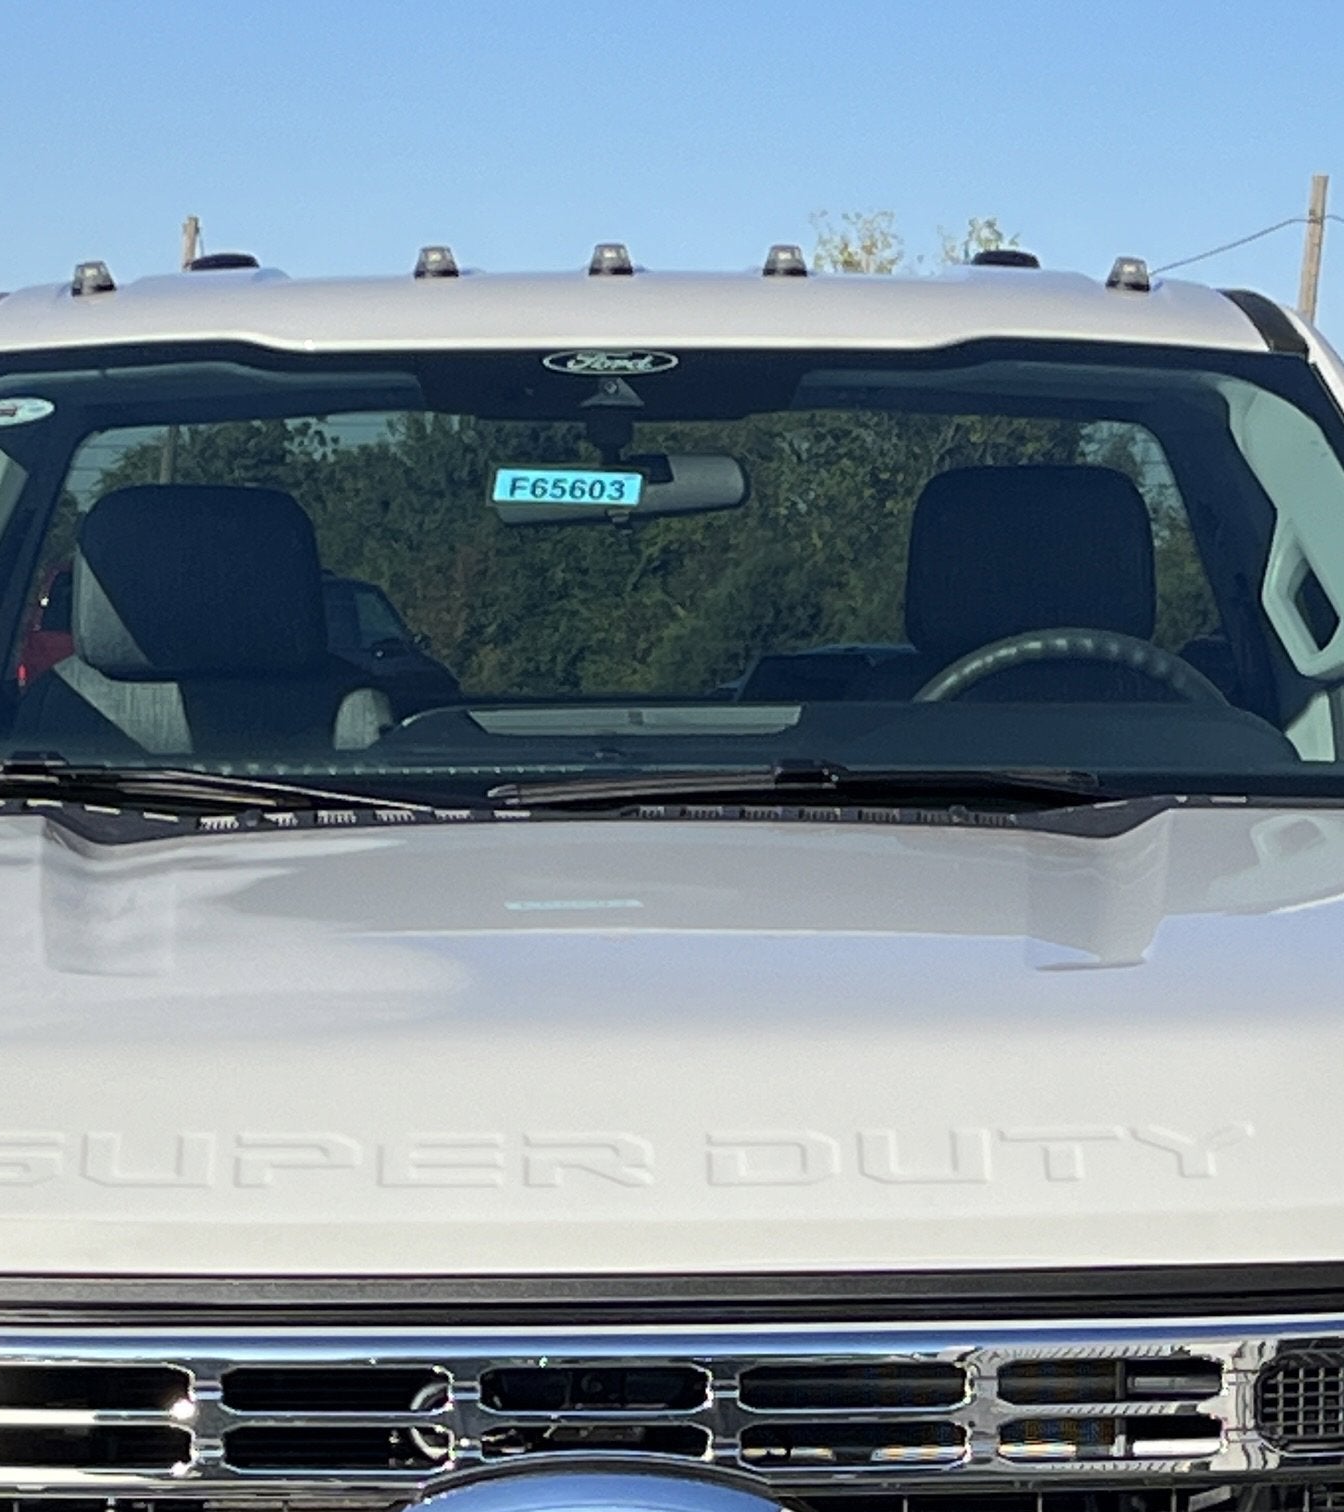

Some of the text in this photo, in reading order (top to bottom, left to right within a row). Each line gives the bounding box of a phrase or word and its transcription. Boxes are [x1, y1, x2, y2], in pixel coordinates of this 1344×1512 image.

[566, 351, 654, 372] Ford
[509, 477, 625, 501] F65603
[705, 1121, 1254, 1187] DUTY
